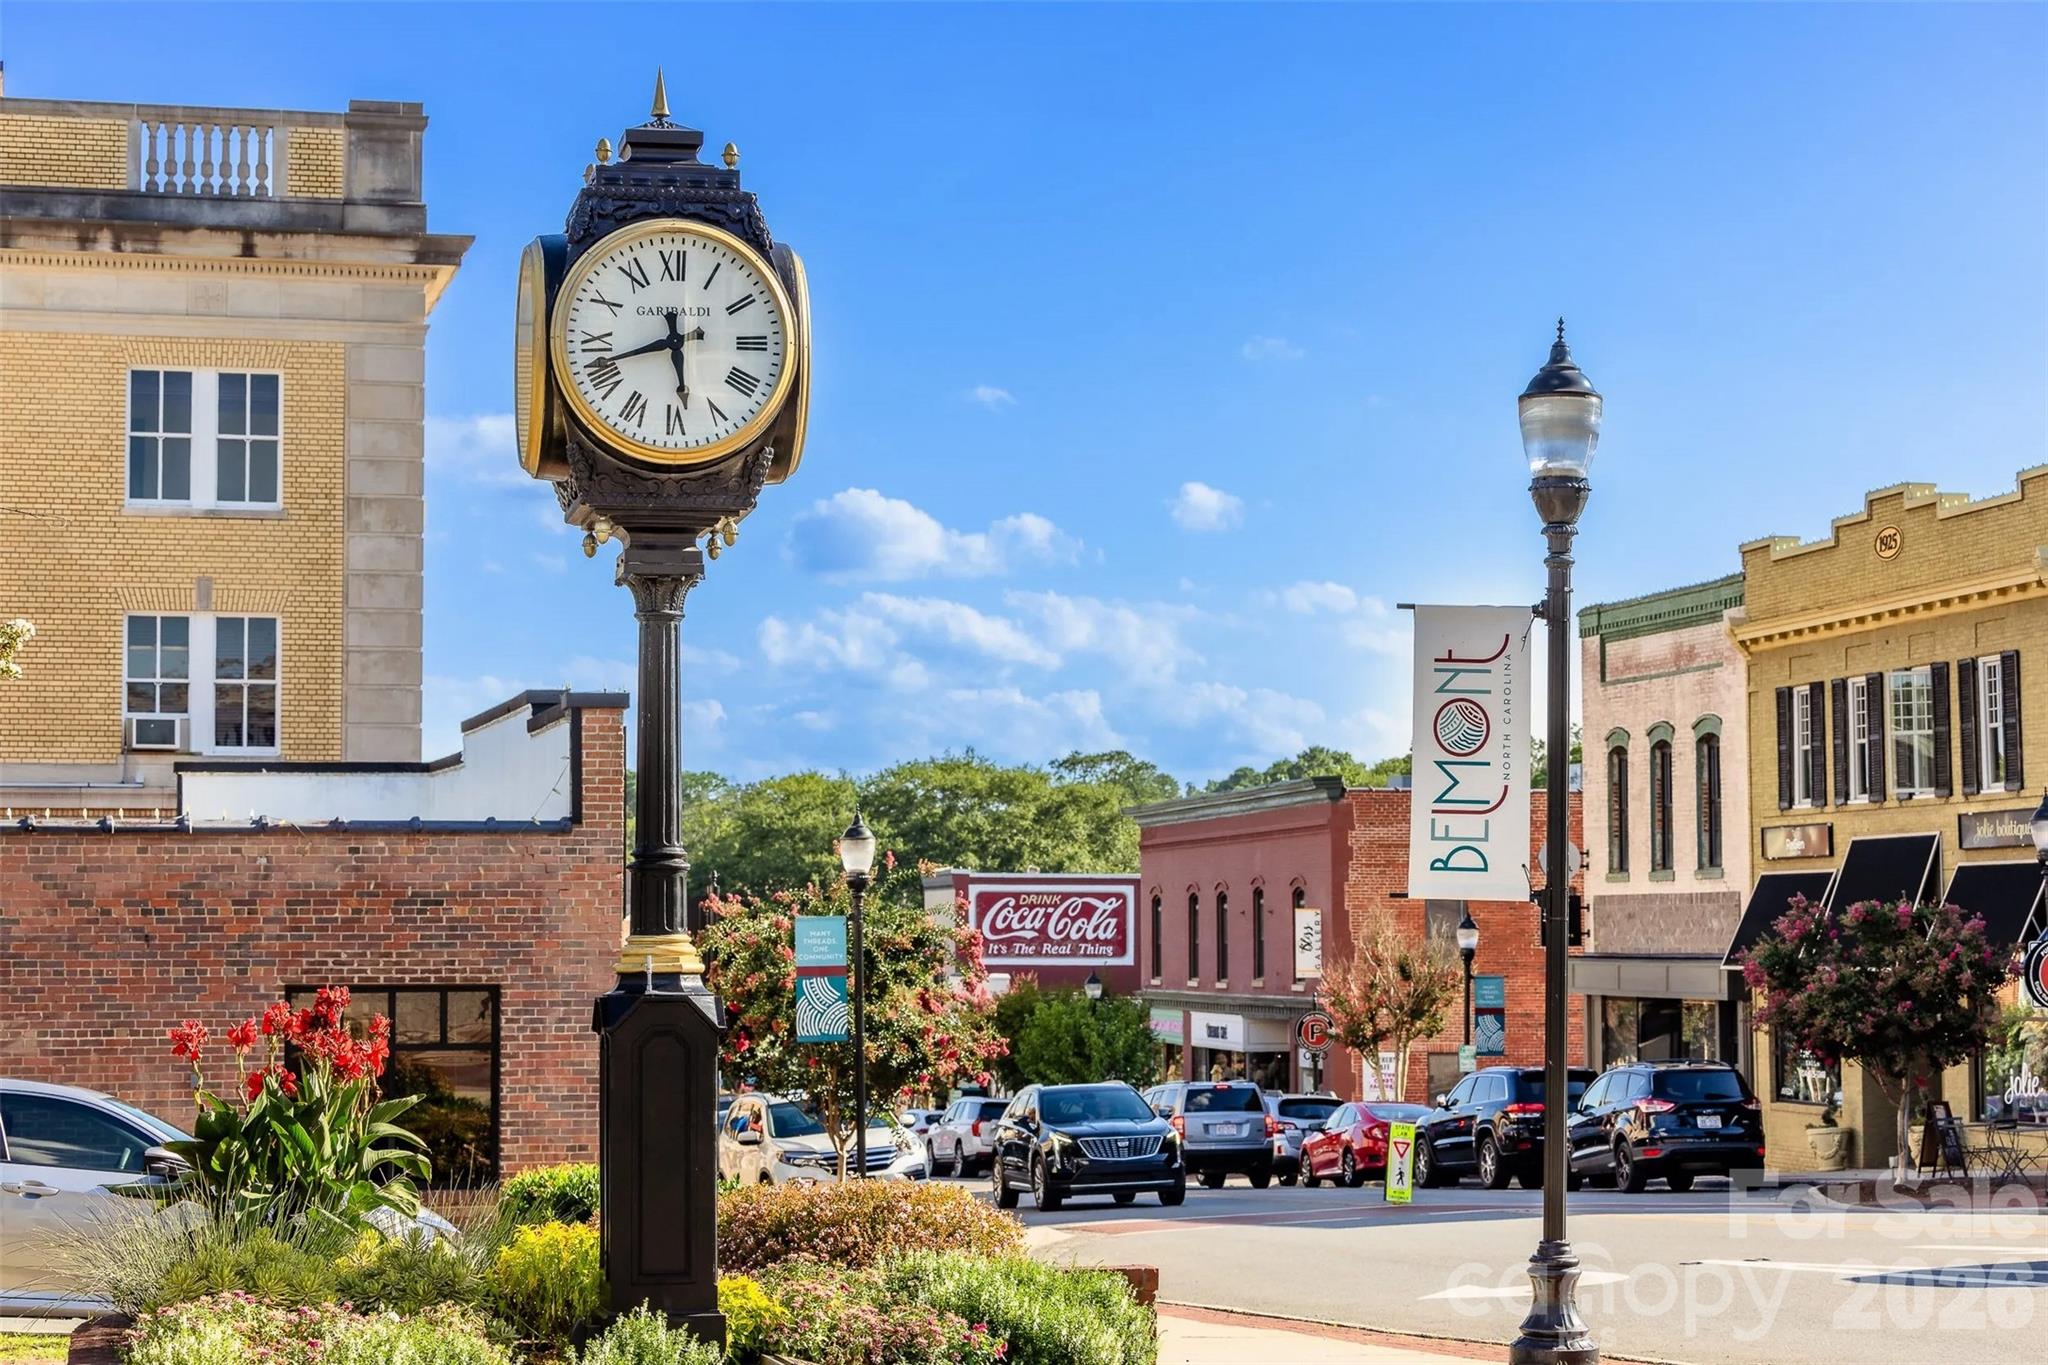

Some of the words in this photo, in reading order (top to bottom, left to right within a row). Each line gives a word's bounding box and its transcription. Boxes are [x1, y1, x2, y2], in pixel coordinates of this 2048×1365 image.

[659, 250, 687, 282] XII
[636, 306, 711, 317] GARIBALDI
[1879, 532, 1897, 552] 1925
[1503, 654, 1511, 725] CAROLINA
[1429, 633, 1510, 872] BELMONT
[1503, 733, 1511, 781] NORTH
[1973, 817, 1995, 844] jolie
[1019, 894, 1062, 905] DRINK
[982, 896, 1123, 940] Coca-Cola
[988, 943, 1007, 955] It's
[1014, 944, 1035, 955] The
[1042, 944, 1071, 955] Real
[1080, 944, 1113, 957] Thing
[1309, 1022, 1326, 1042] P
[2004, 1062, 2040, 1105] jolie
